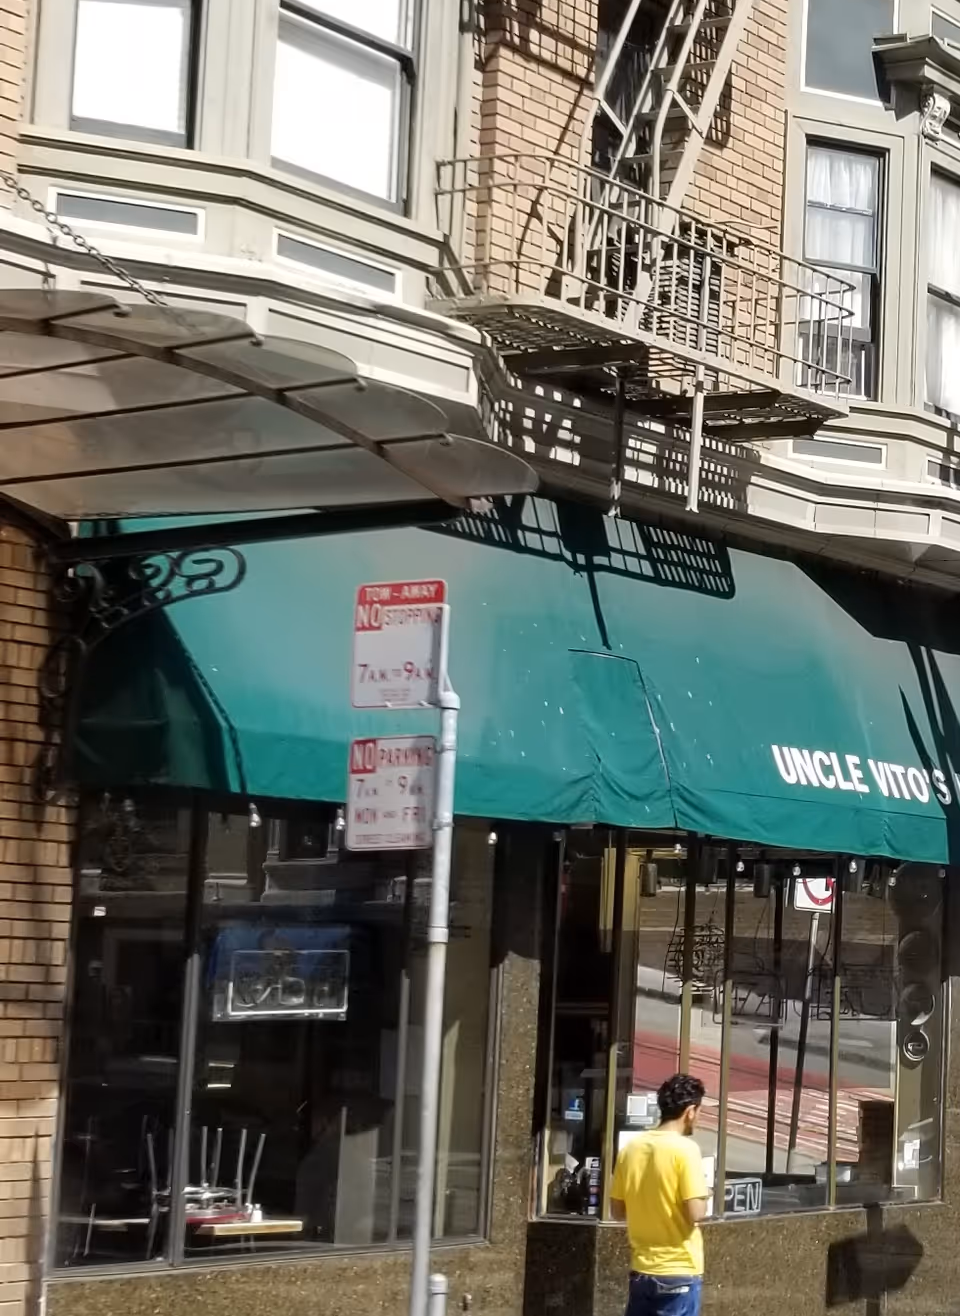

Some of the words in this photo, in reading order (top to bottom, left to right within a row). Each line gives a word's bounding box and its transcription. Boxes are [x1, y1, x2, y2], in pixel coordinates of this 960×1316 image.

[357, 603, 382, 628] NO
[352, 743, 375, 771] NO
[771, 744, 870, 793] UNCLE
[867, 759, 951, 805] VITO'S
[724, 1182, 760, 1212] PEN
